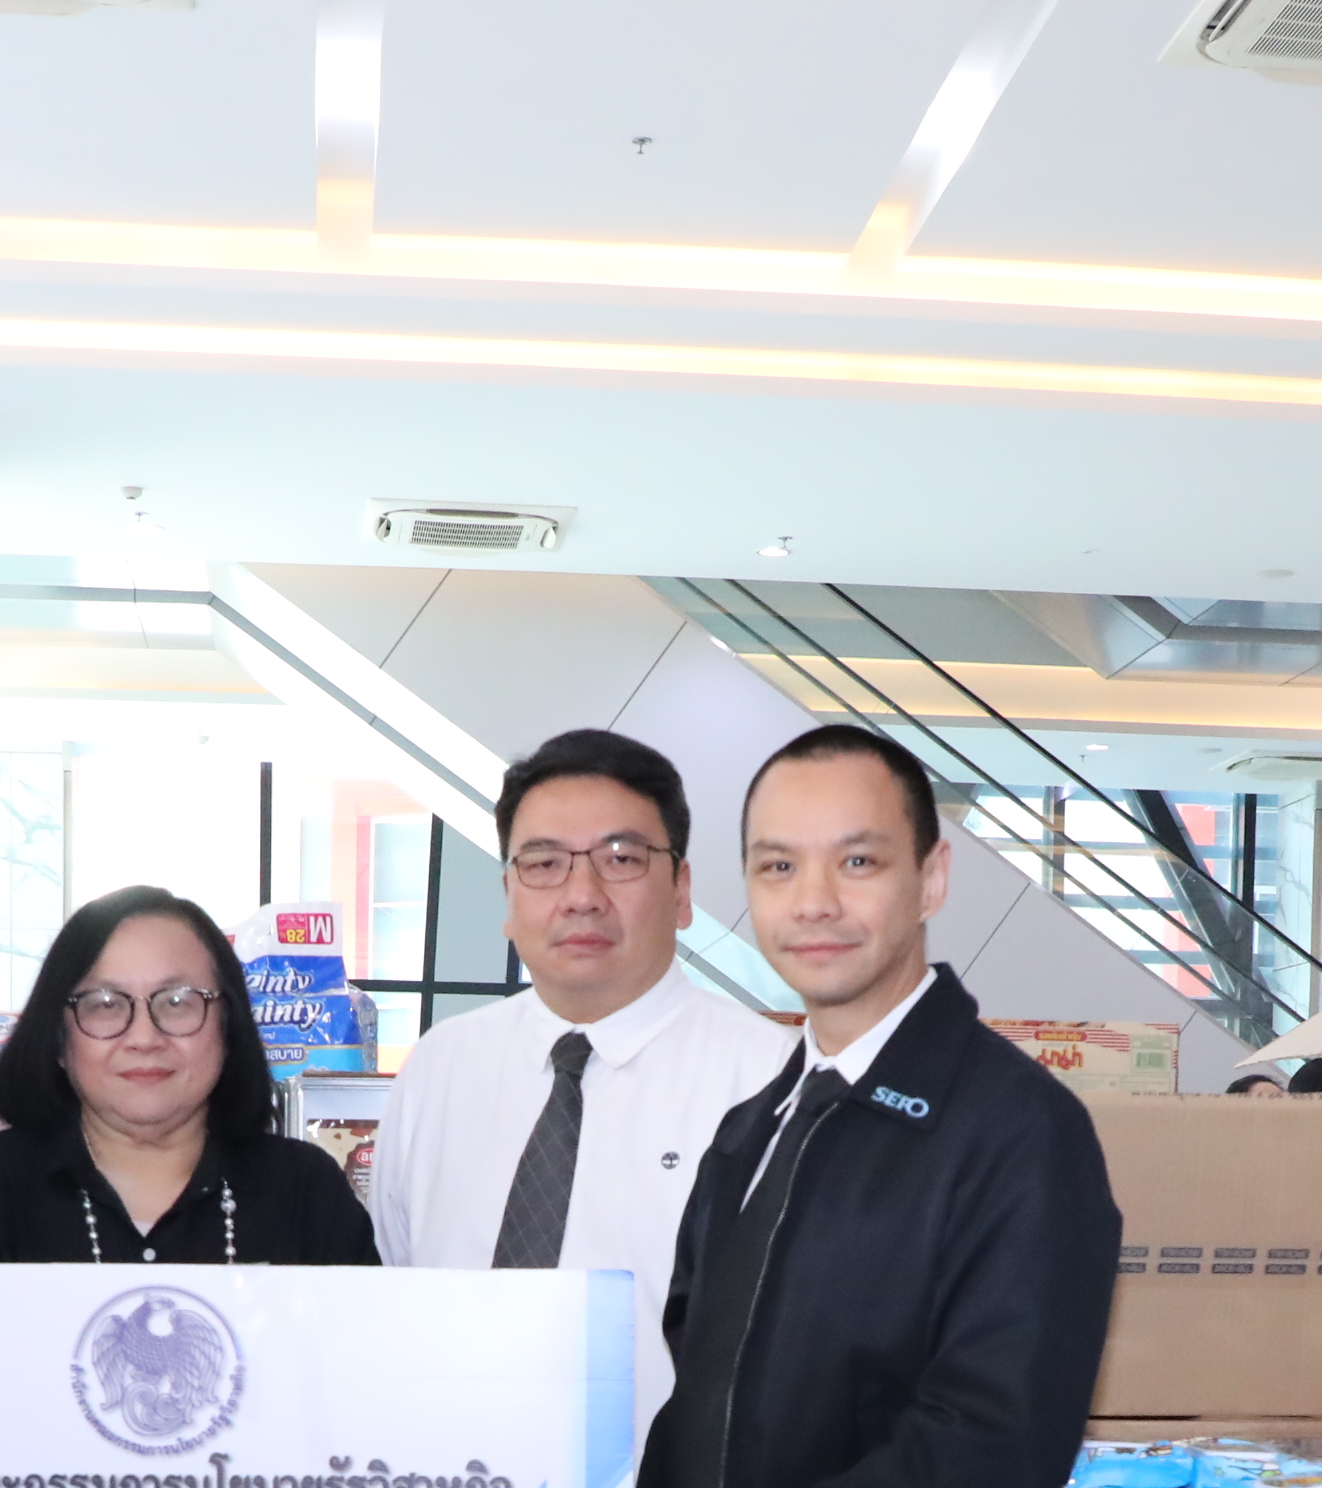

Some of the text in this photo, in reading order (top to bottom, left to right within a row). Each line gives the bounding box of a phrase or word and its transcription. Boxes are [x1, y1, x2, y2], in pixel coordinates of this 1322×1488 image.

[309, 916, 332, 942] M
[246, 968, 311, 993] ainty
[252, 1002, 321, 1031] ainty
[360, 1151, 374, 1162] ar
